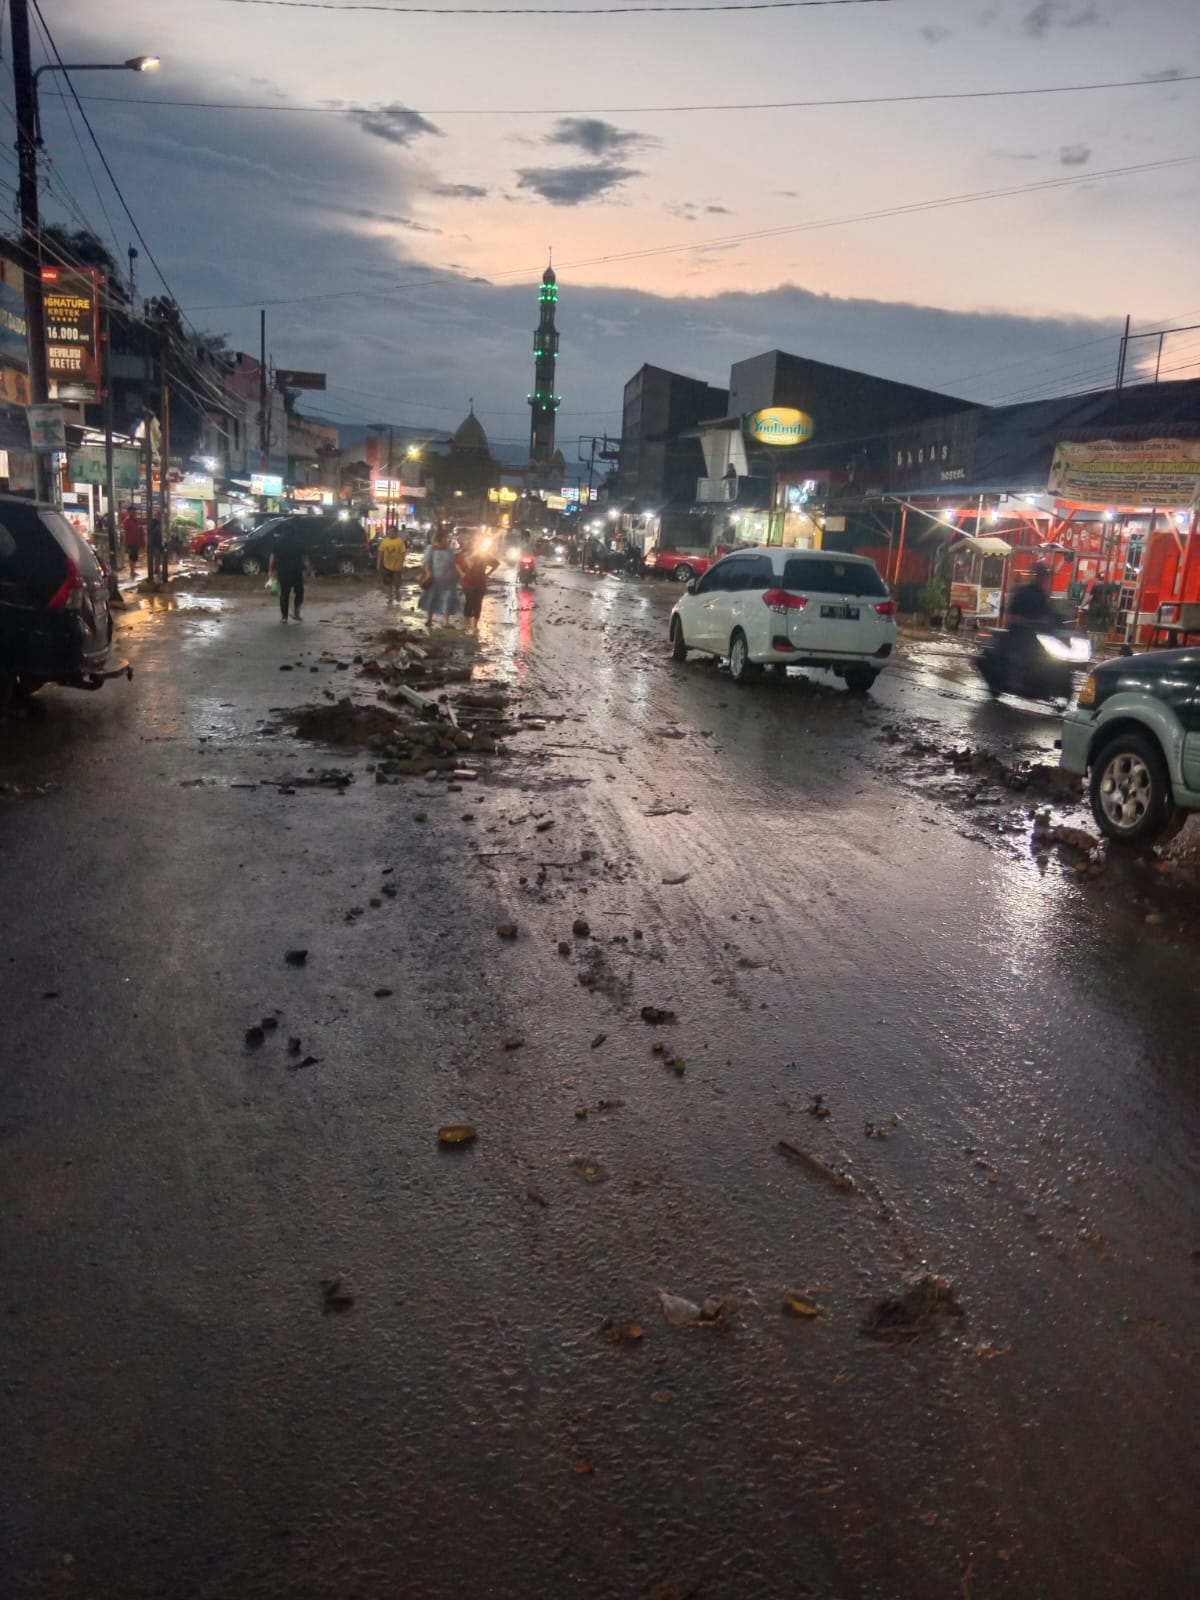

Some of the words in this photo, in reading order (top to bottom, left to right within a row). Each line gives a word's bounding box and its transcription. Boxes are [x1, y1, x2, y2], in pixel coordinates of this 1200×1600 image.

[44, 298, 90, 309] IGNATURE
[47, 308, 80, 317] KRETEK
[47, 327, 78, 340] 16.000
[50, 358, 81, 369] KRETEK
